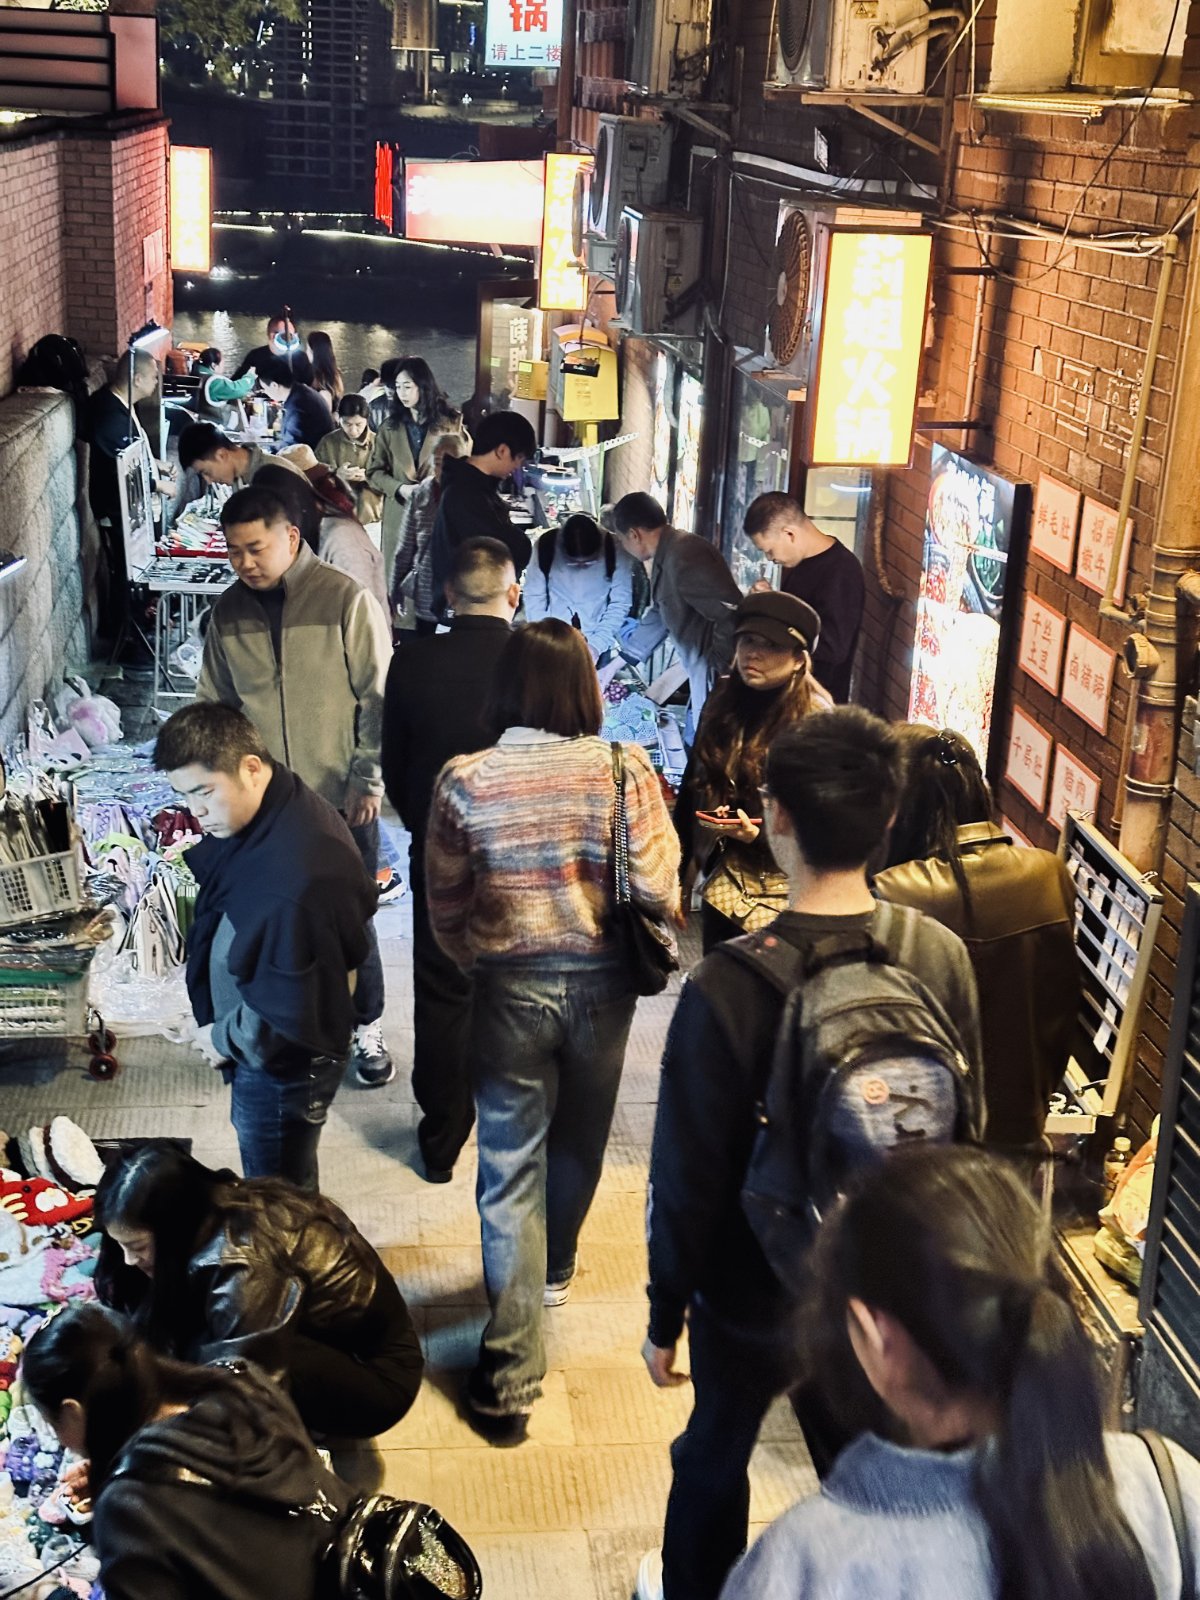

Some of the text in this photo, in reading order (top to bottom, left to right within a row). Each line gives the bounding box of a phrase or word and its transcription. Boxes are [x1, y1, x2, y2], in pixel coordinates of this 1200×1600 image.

[508, 0, 547, 32] 锅
[491, 43, 561, 62] 请上二楼
